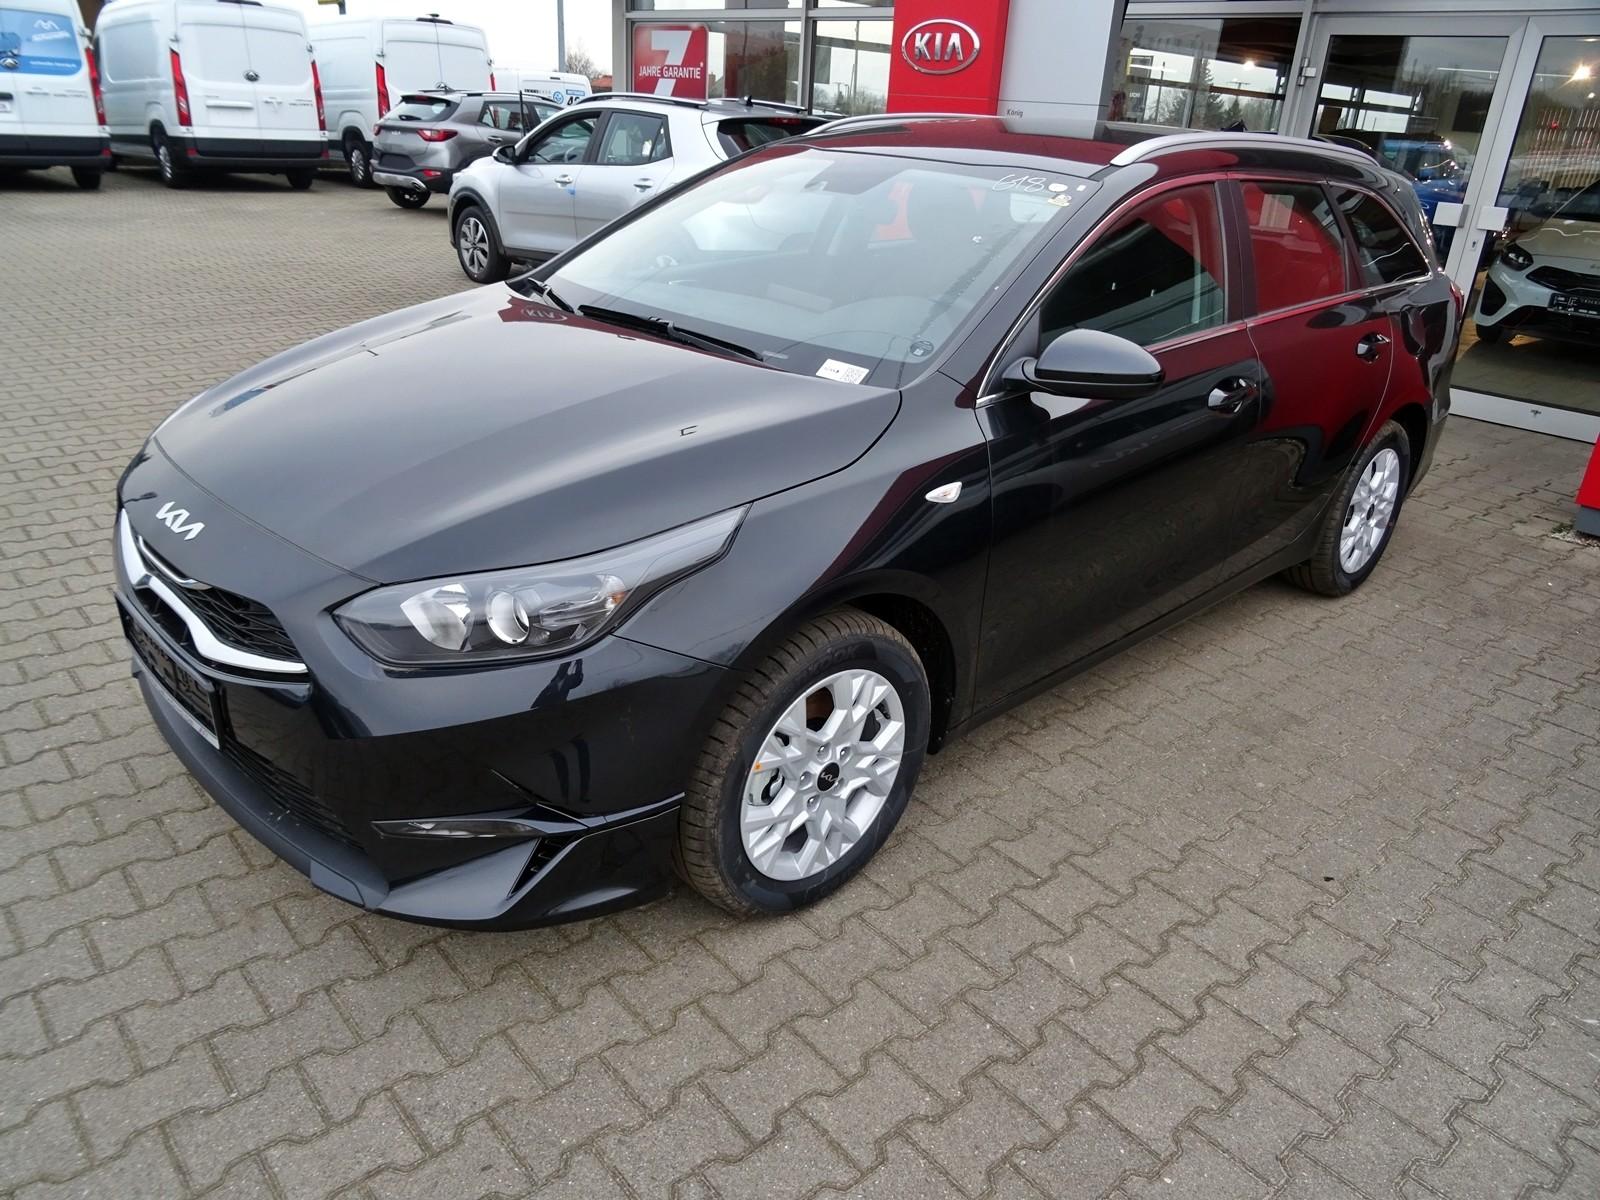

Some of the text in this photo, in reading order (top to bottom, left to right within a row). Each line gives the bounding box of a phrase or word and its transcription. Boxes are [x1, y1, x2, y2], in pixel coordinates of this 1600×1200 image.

[651, 30, 693, 97] 7
[914, 32, 964, 62] KIA
[639, 66, 661, 77] JAHRE
[155, 501, 206, 541] KIA
